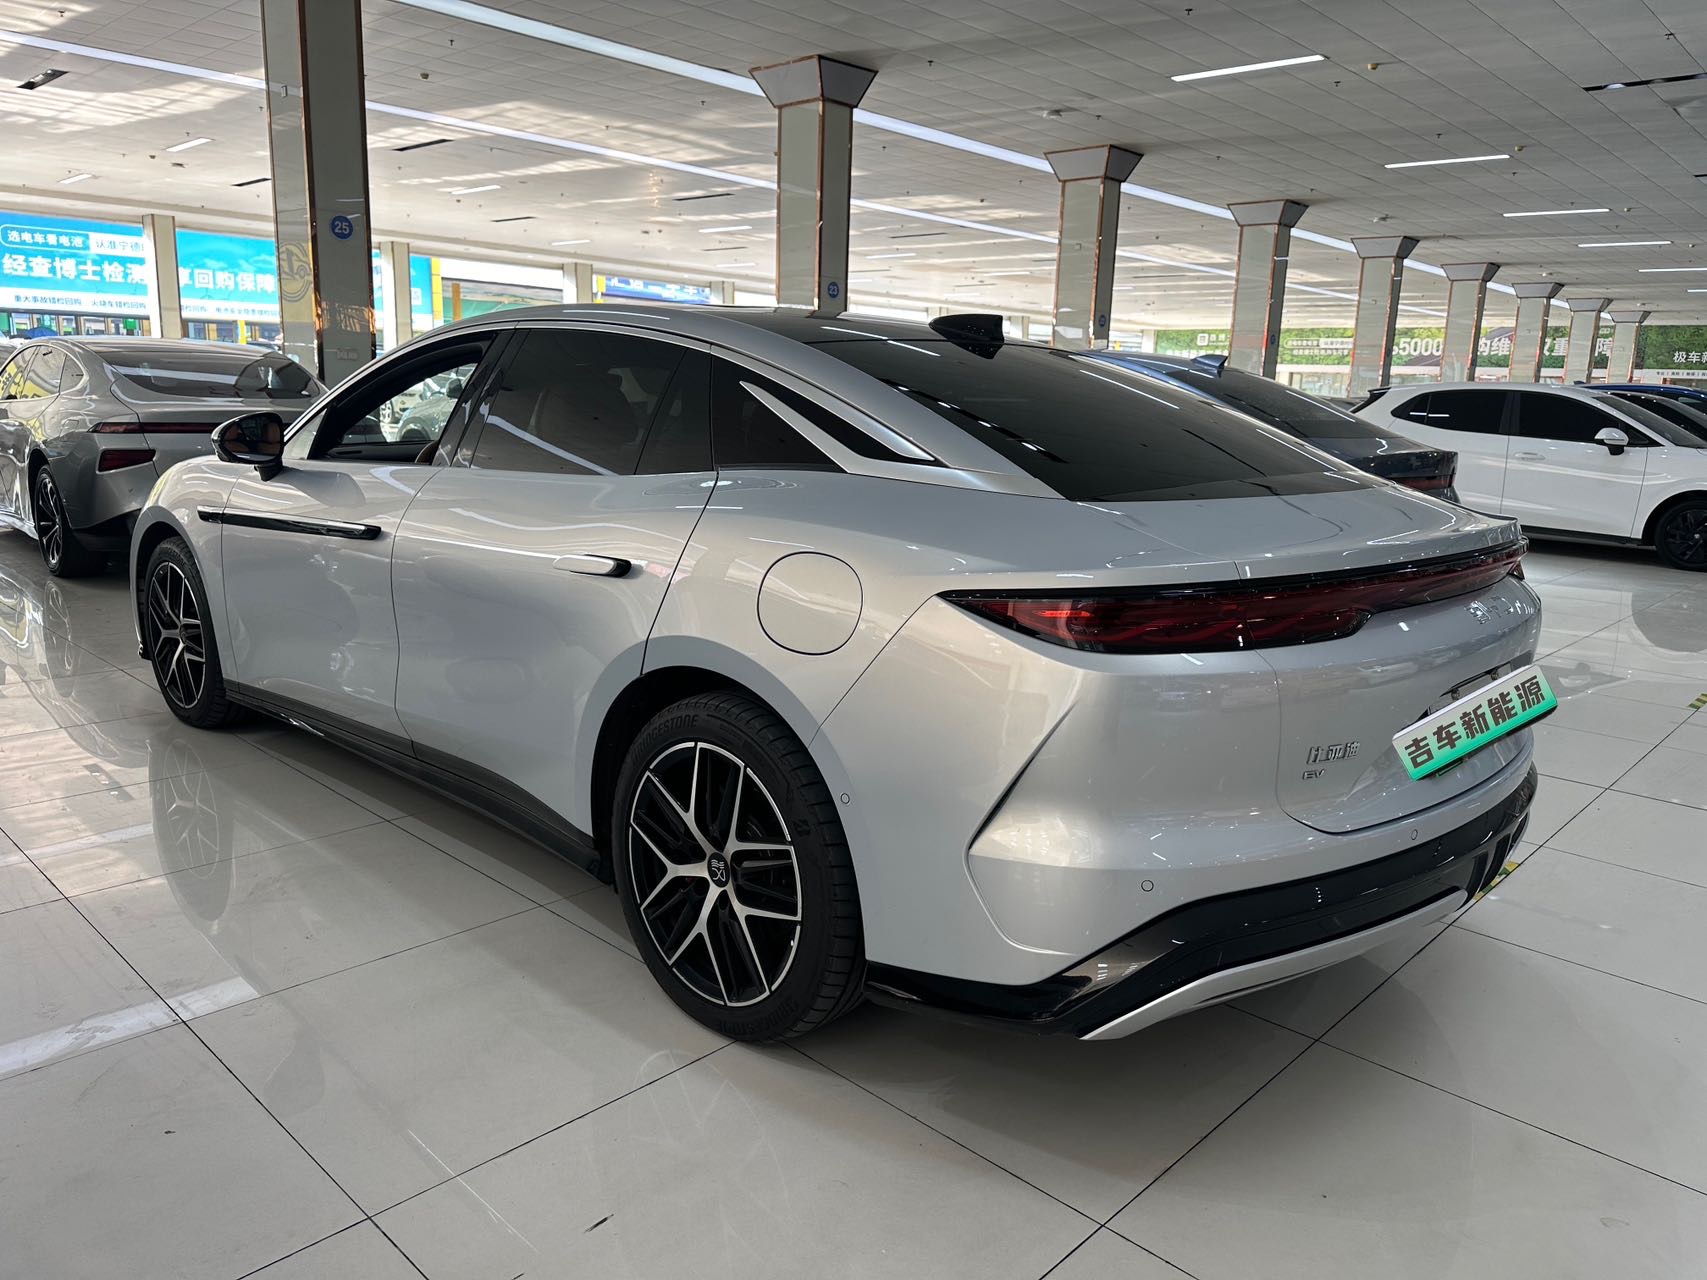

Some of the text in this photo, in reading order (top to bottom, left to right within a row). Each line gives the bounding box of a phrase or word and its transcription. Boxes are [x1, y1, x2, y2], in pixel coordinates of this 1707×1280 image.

[334, 221, 350, 234] 25
[7, 230, 145, 252] 选电车看电池 认准宁德
[1393, 337, 1443, 356] 5000
[1404, 674, 1546, 769] 吉车新能源
[1306, 741, 1360, 764] 比亚迪
[1302, 769, 1325, 780] EV
